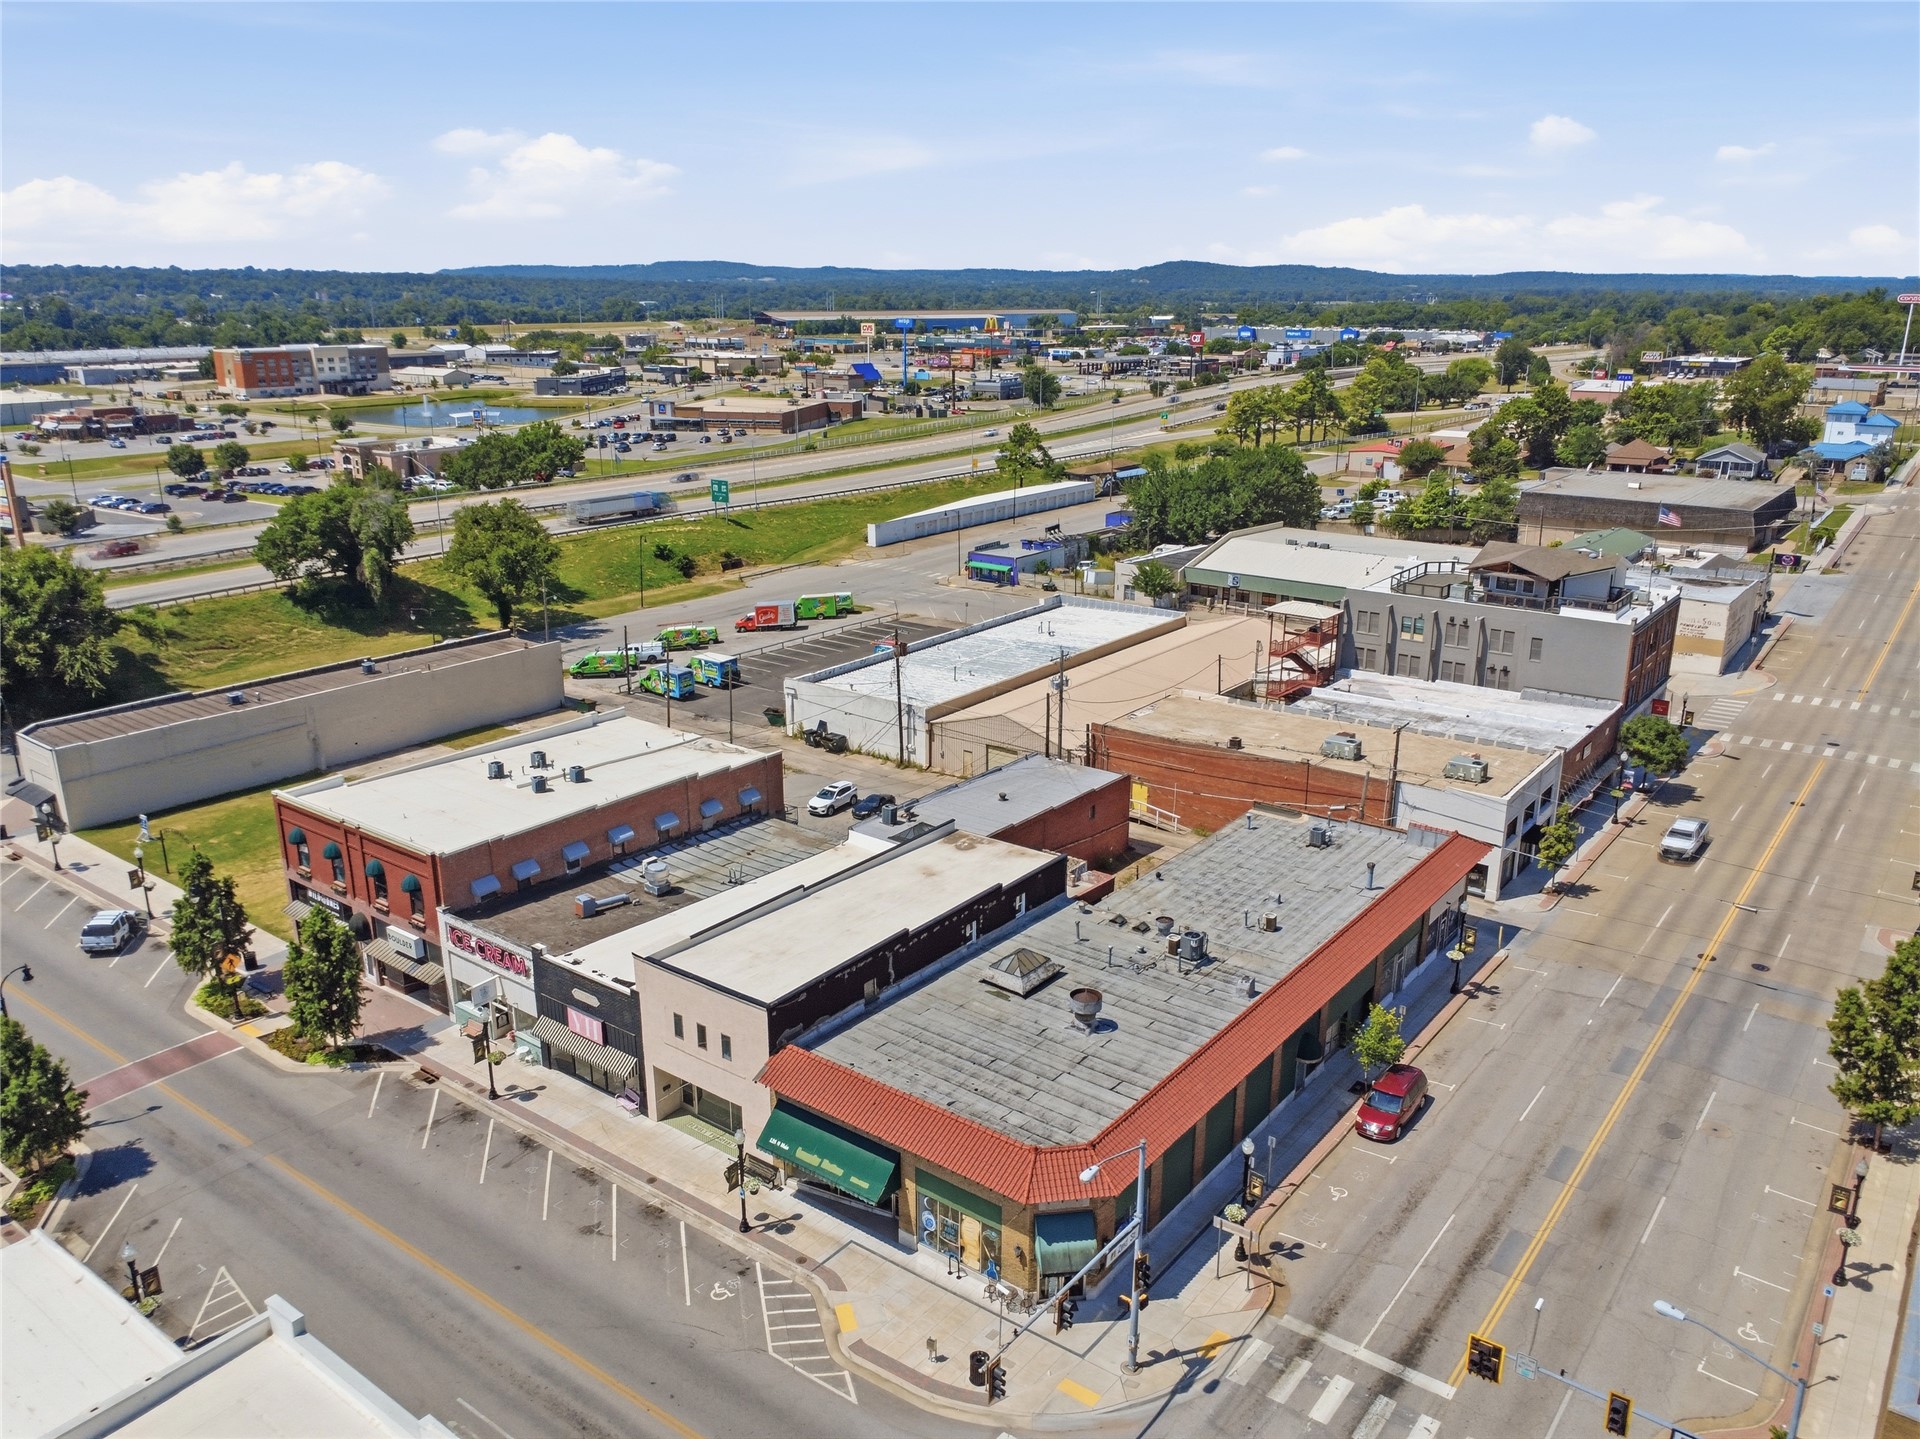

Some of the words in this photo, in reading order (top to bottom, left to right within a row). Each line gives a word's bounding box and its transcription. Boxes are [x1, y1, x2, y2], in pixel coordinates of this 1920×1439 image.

[862, 324, 873, 332] CVS
[387, 933, 413, 950] BOULDER
[448, 926, 473, 953] ICE
[475, 938, 528, 977] CREAM
